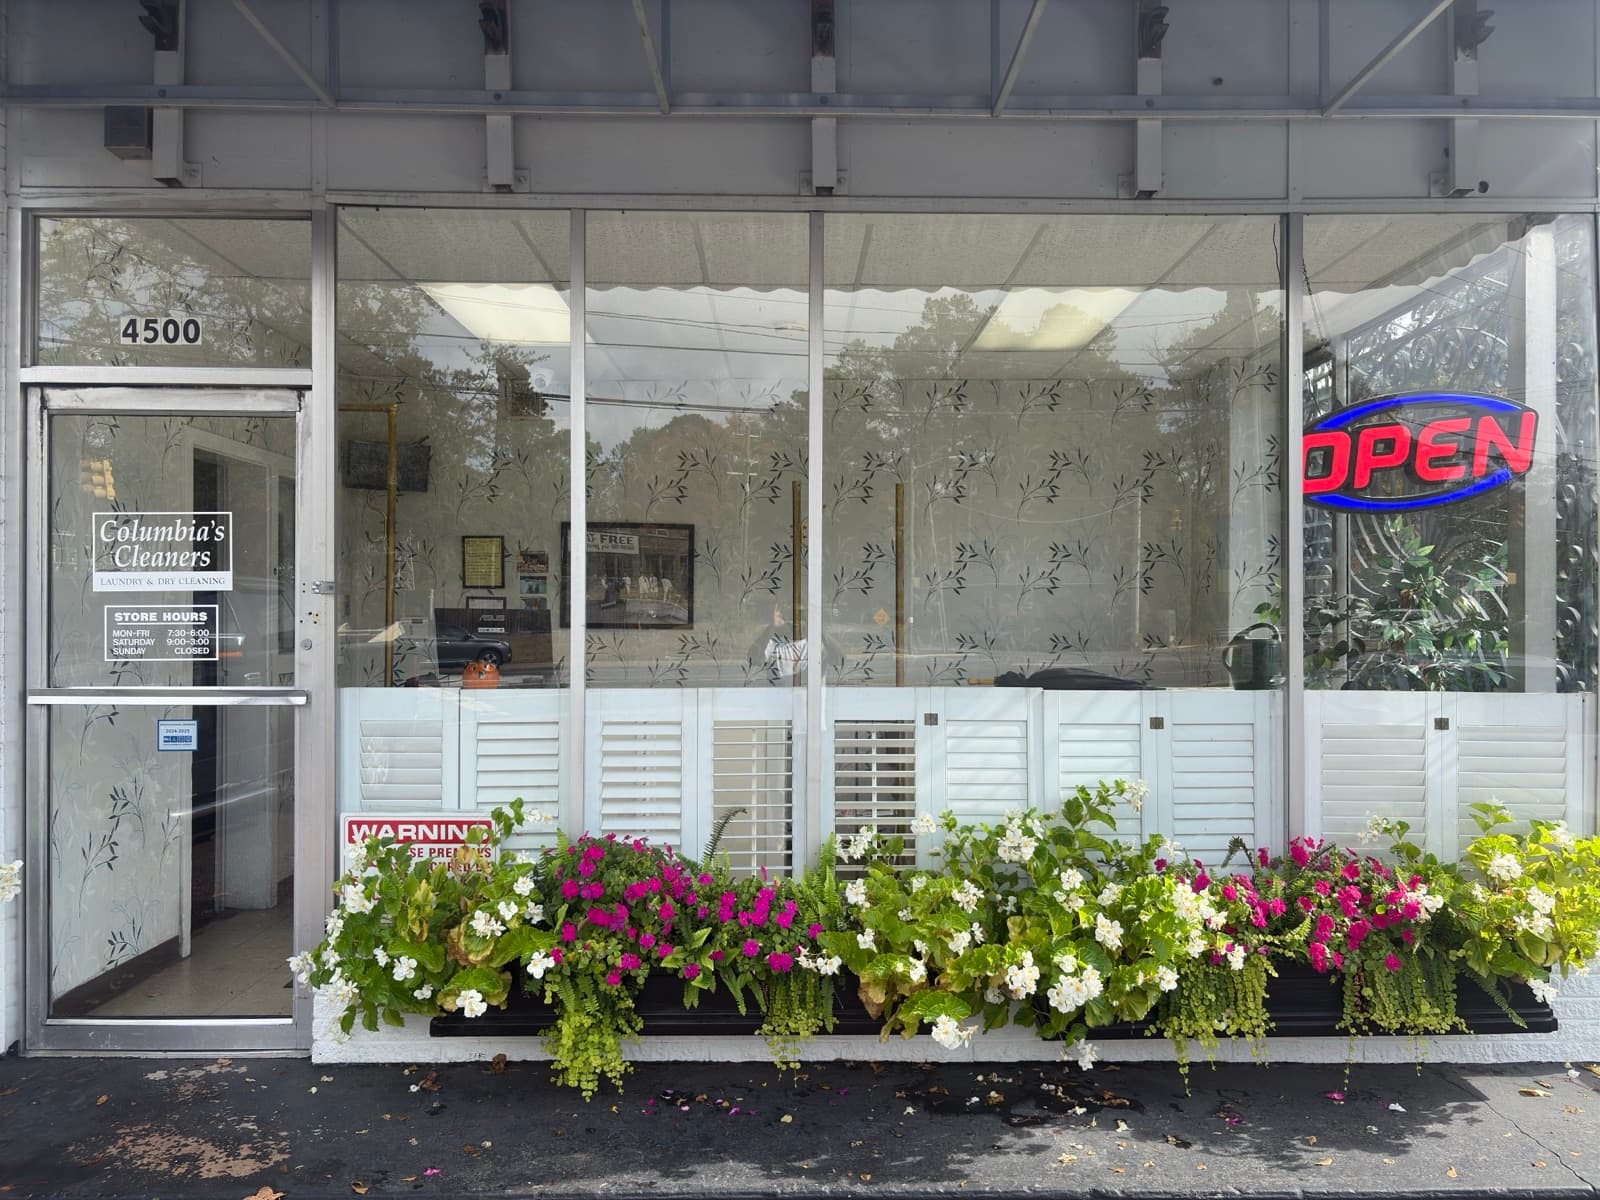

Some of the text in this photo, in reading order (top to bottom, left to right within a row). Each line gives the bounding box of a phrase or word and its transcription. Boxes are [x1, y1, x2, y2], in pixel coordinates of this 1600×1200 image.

[122, 318, 200, 343] 4500
[1303, 411, 1536, 494] OPEN
[100, 519, 225, 542] Columbia's
[600, 534, 634, 545] FREE
[114, 545, 211, 567] Cleaners
[100, 577, 225, 586] LAUNDRY & DRY CLEANING
[114, 611, 208, 622] STORE HOURS
[112, 629, 210, 637] MON-FRI 7:30-6:00
[112, 638, 210, 646] SATURDAY 9:00-3:00
[112, 647, 210, 655] SUNDAY CLOSED
